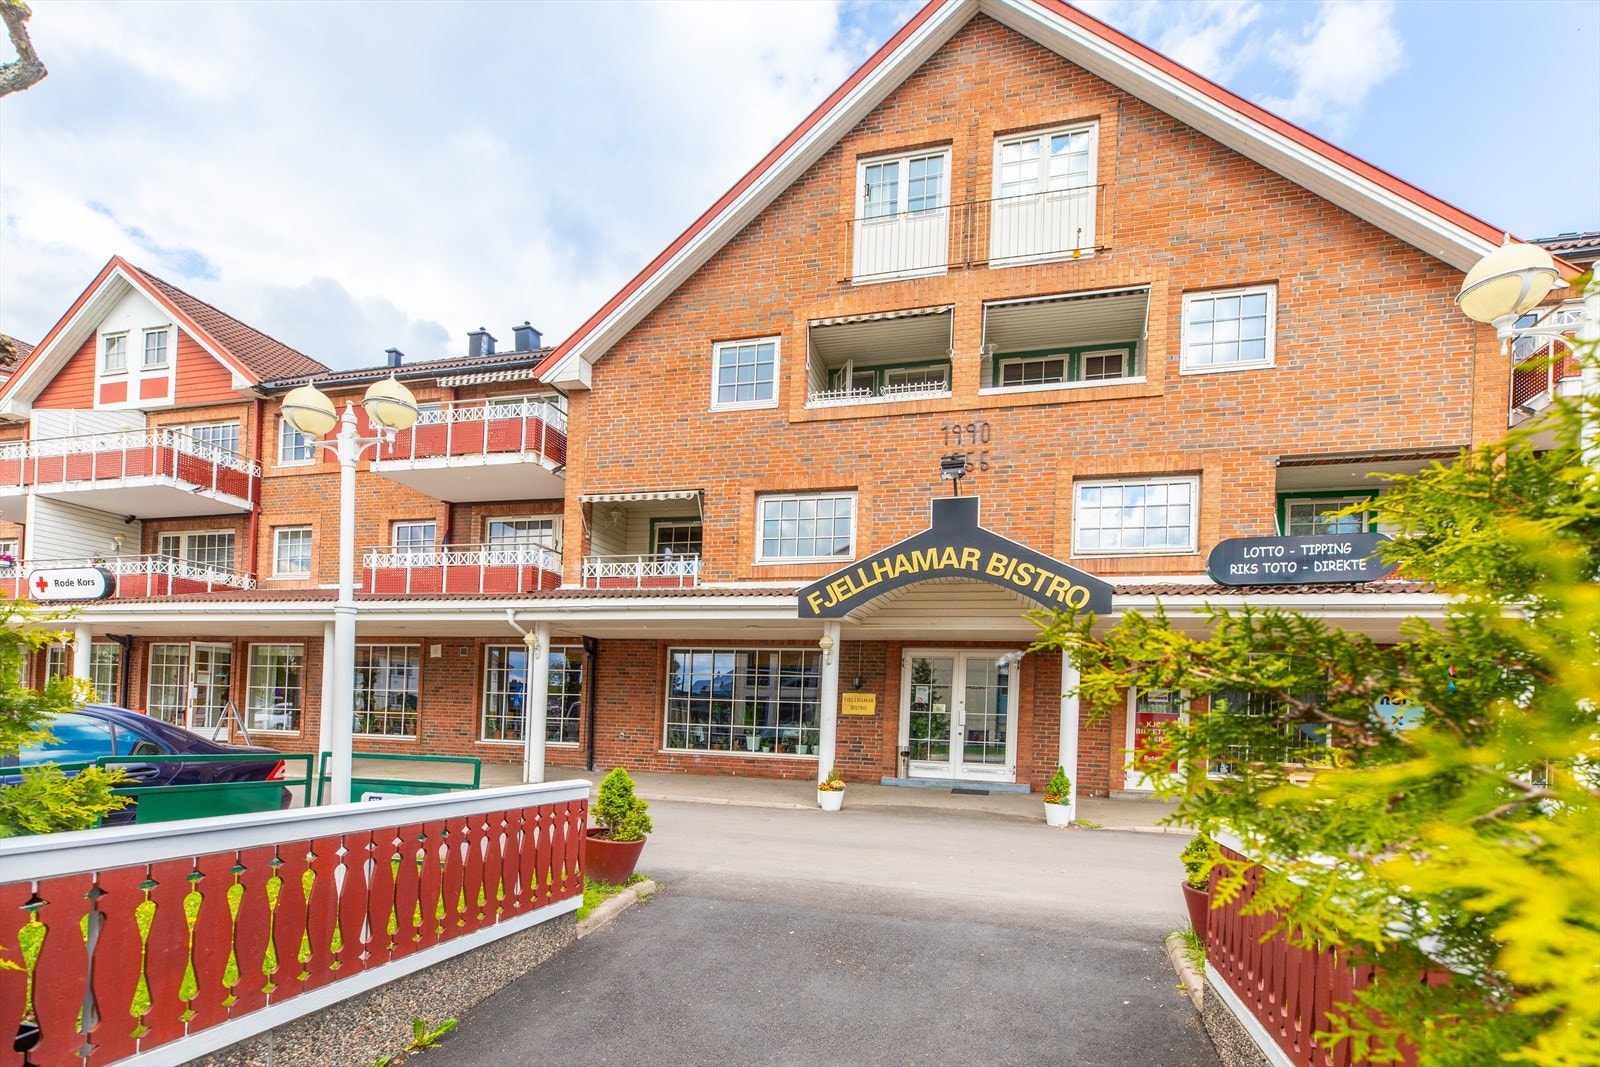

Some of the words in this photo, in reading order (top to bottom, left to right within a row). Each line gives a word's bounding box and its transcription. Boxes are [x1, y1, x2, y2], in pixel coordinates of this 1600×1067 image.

[941, 423, 990, 445] 1990
[1243, 546, 1284, 558] LOTTO
[1300, 543, 1352, 556] TIPPING
[1230, 563, 1259, 575] RIKS
[1262, 561, 1297, 574] TOTO
[1314, 558, 1367, 573] DIREKTE
[77, 577, 96, 588] Kors
[806, 546, 982, 615] FJELLHAMAR
[985, 552, 1090, 609] BISTRO
